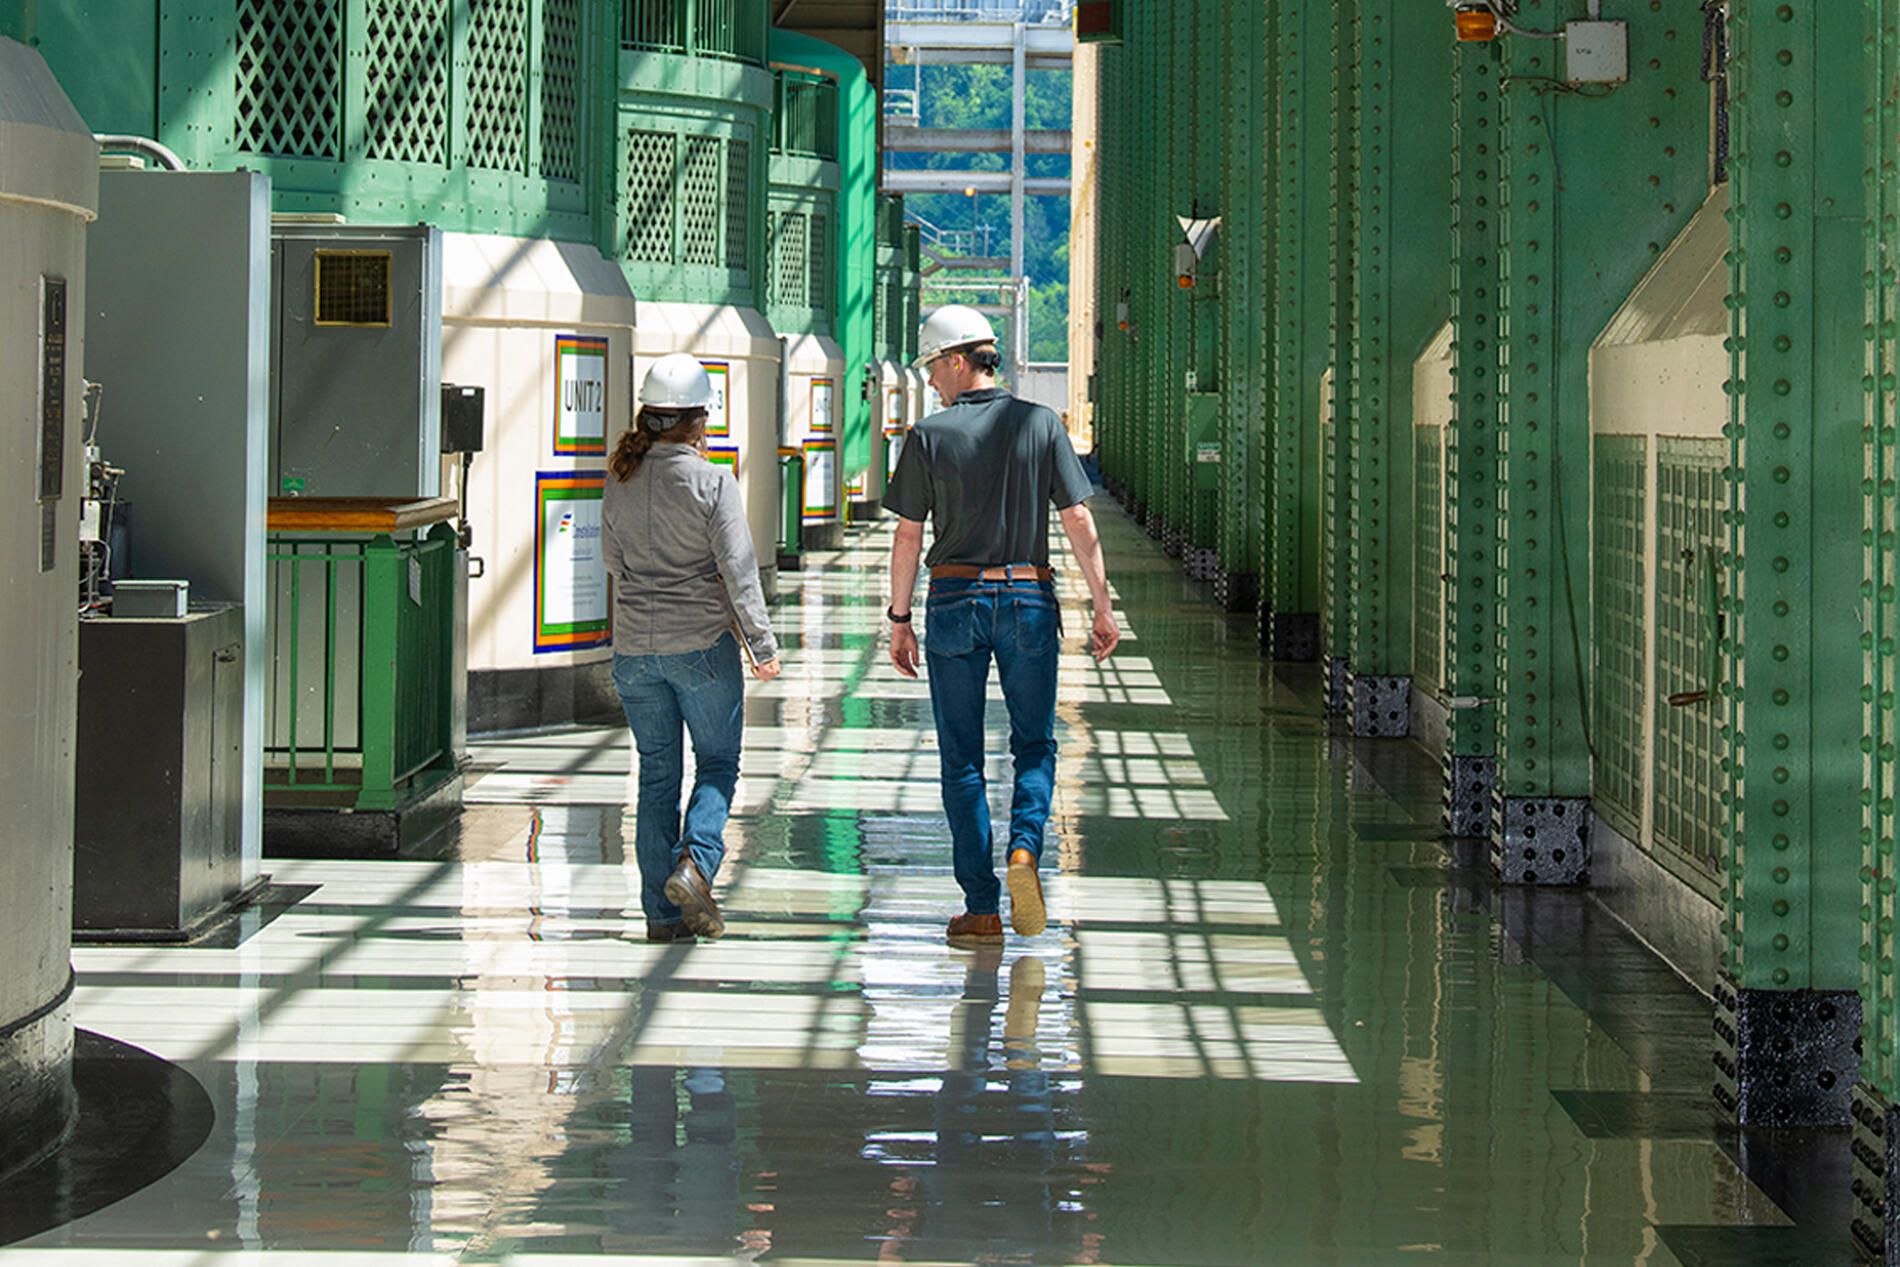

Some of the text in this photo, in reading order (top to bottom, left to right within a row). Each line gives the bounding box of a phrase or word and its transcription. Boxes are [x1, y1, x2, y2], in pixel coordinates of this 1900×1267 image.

[565, 380, 603, 412] UNIT 2
[717, 389, 724, 410] 3
